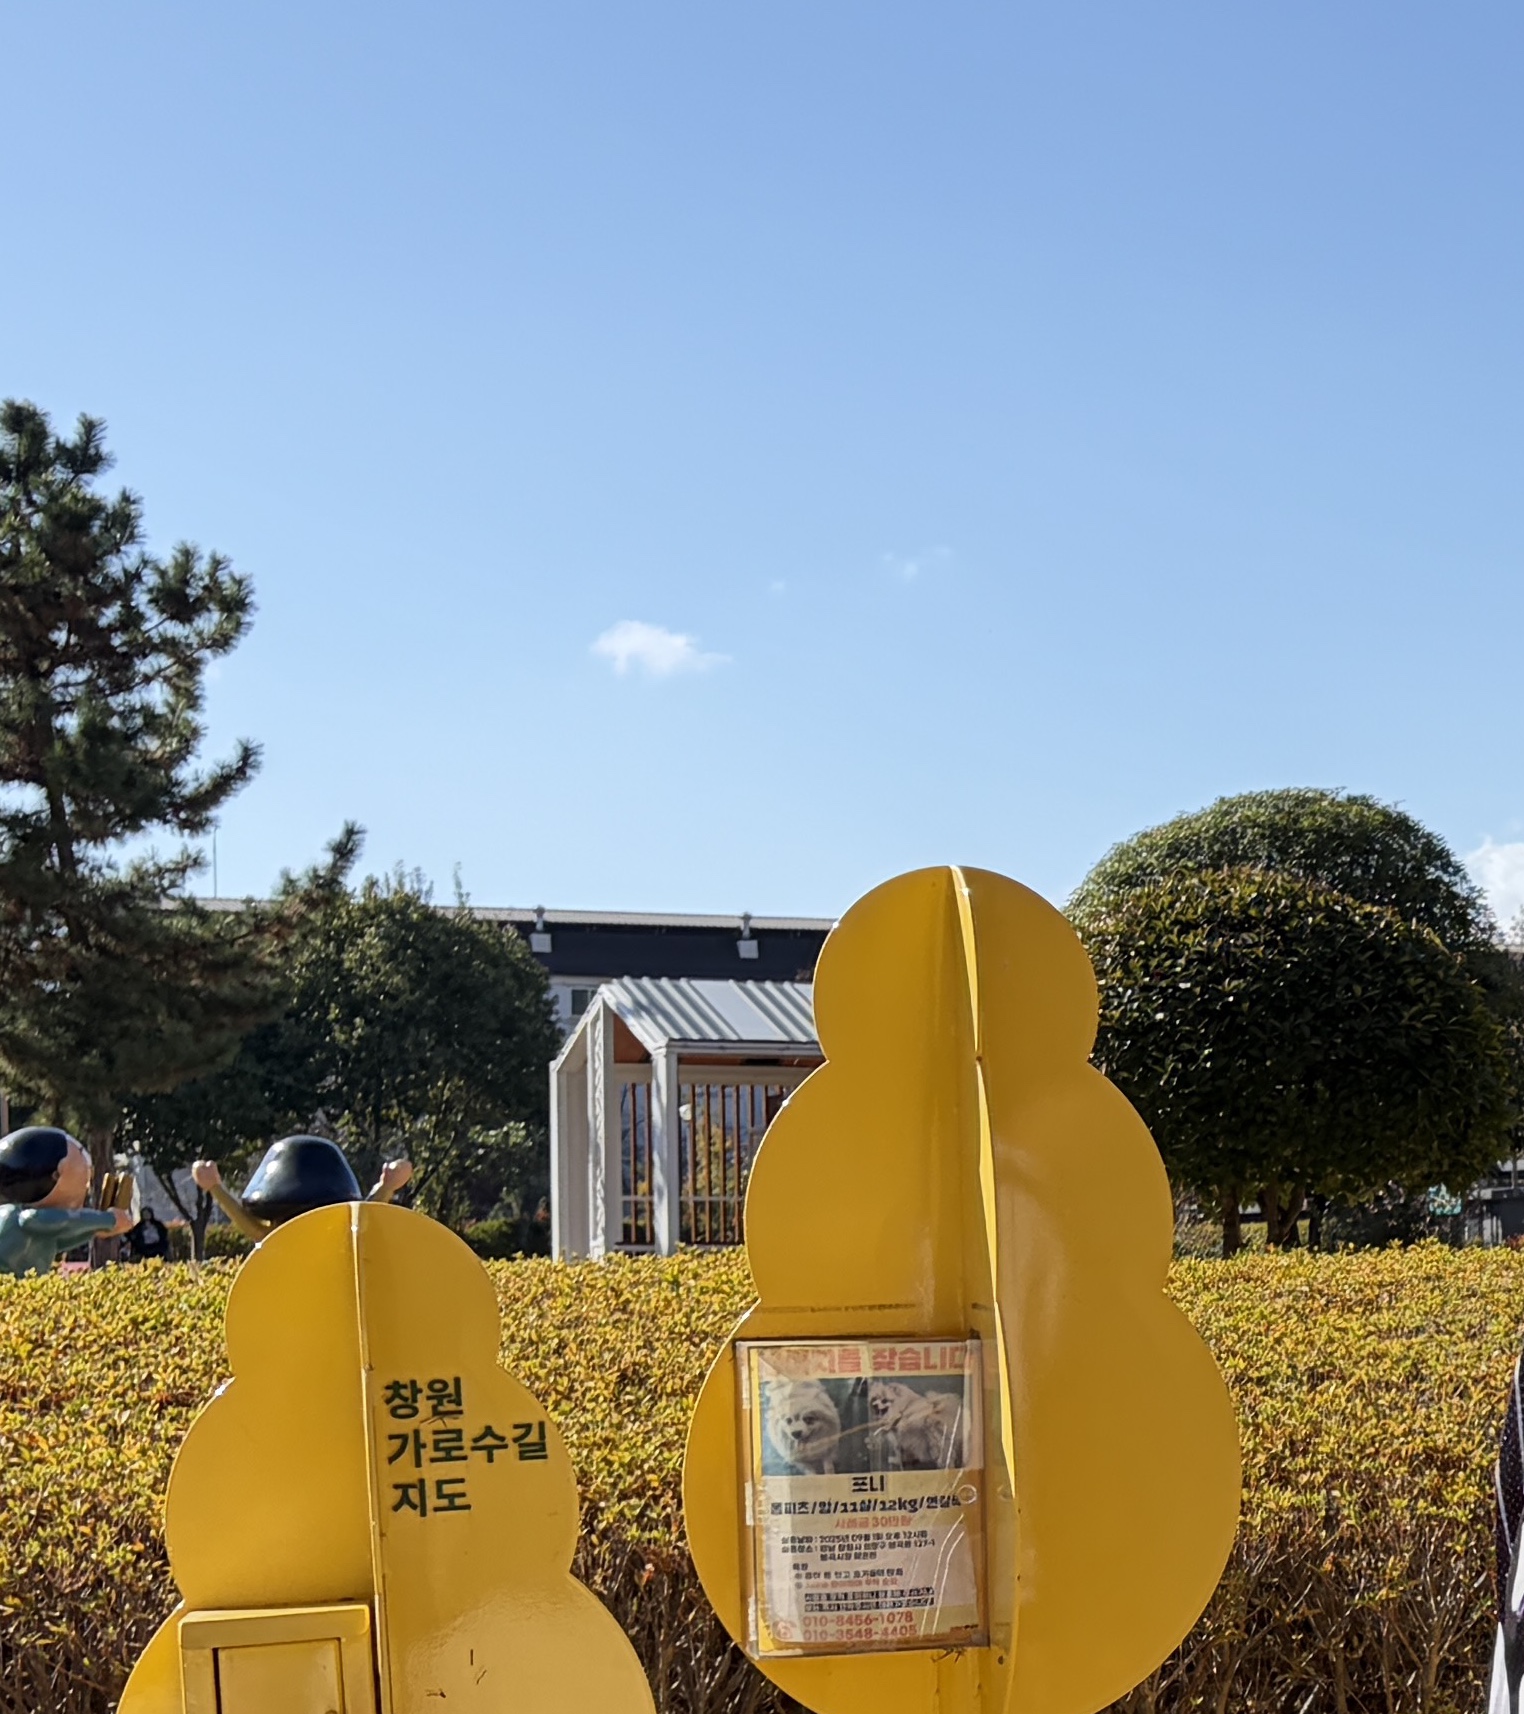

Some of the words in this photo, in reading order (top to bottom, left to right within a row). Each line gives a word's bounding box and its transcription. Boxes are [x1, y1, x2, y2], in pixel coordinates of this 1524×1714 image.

[384, 1376, 464, 1420] 창원
[387, 1421, 548, 1468] 가로수길
[391, 1478, 472, 1518] 지도
[802, 1611, 914, 1628] 010-8456-1078
